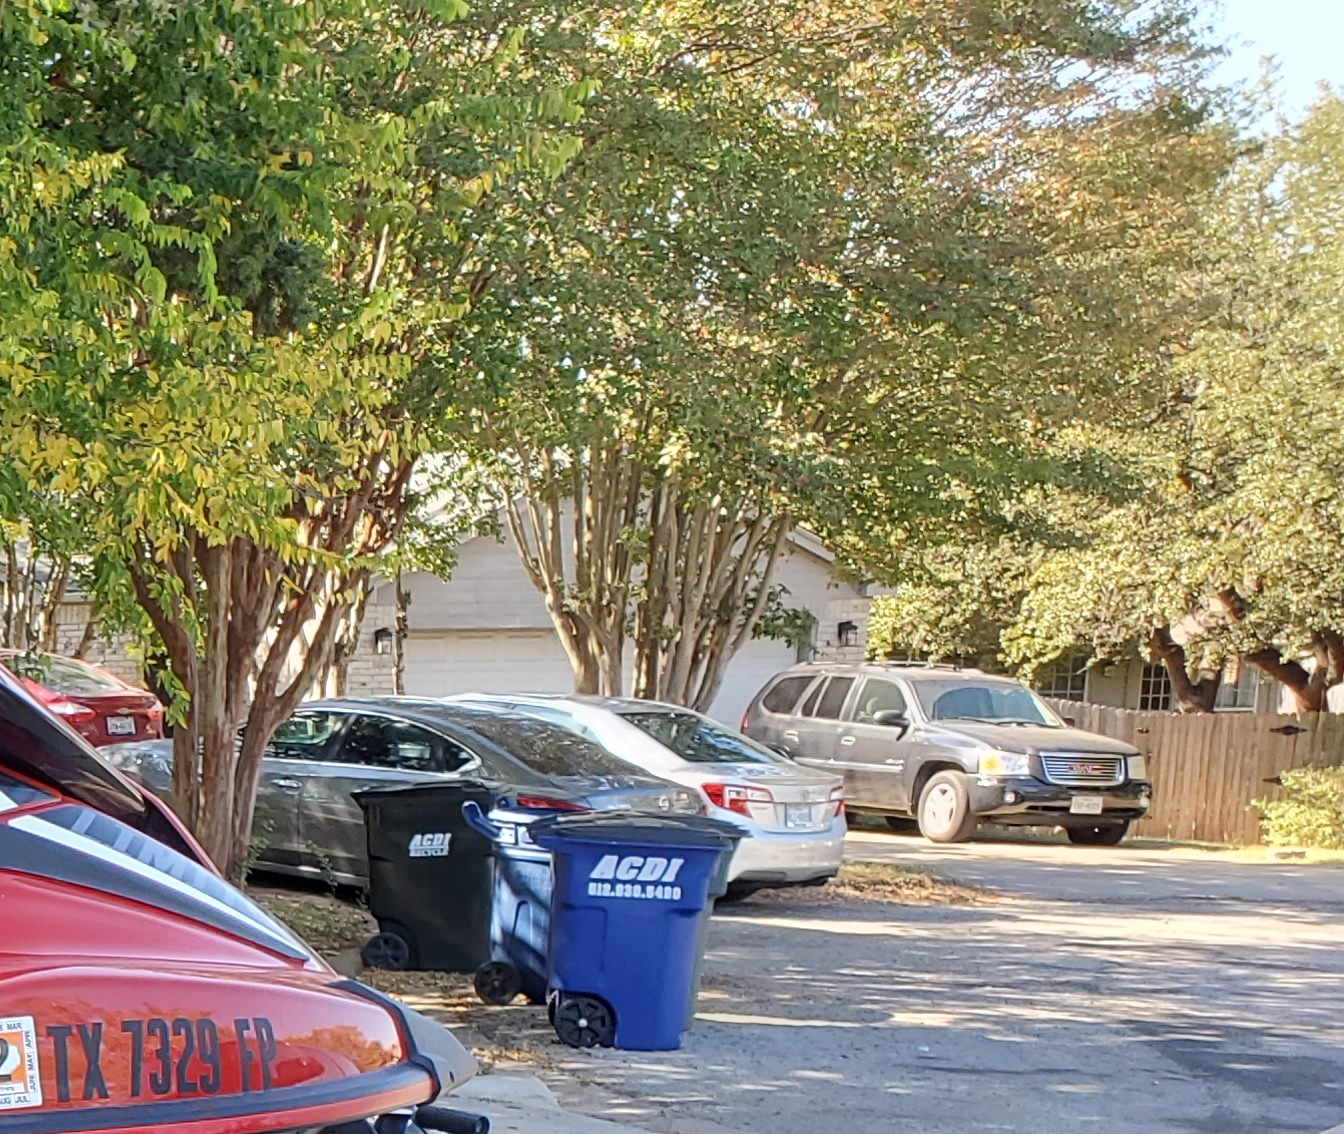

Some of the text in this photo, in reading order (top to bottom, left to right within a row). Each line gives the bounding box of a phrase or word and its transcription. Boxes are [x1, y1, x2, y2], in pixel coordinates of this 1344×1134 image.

[409, 832, 452, 849] ACDI
[590, 854, 685, 883] ACDI
[46, 1022, 109, 1102] TX
[121, 1018, 220, 1097] 7329
